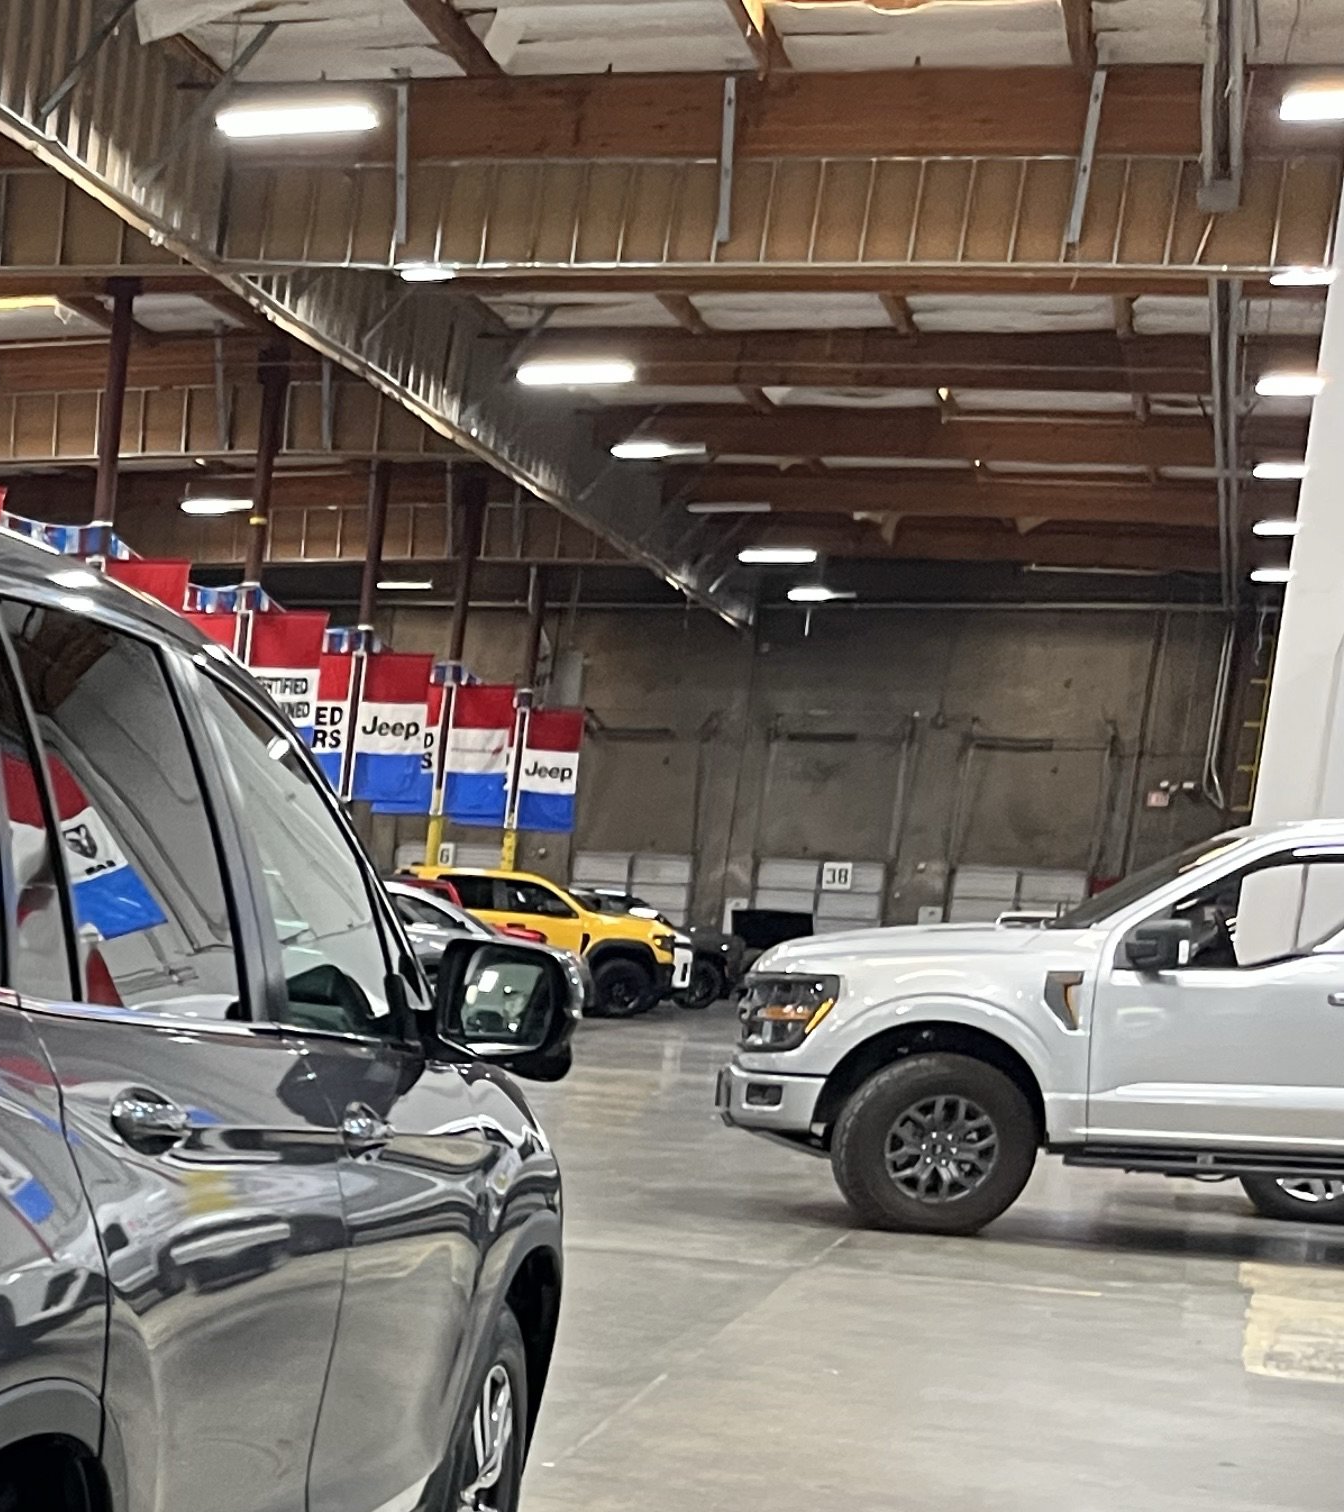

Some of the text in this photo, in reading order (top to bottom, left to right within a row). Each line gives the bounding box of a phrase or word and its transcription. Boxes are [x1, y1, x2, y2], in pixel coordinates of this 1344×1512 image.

[315, 706, 343, 726] ED
[361, 715, 420, 741] Jeep
[312, 729, 341, 749] RS
[524, 760, 573, 782] Jeep
[825, 867, 849, 885] 38
